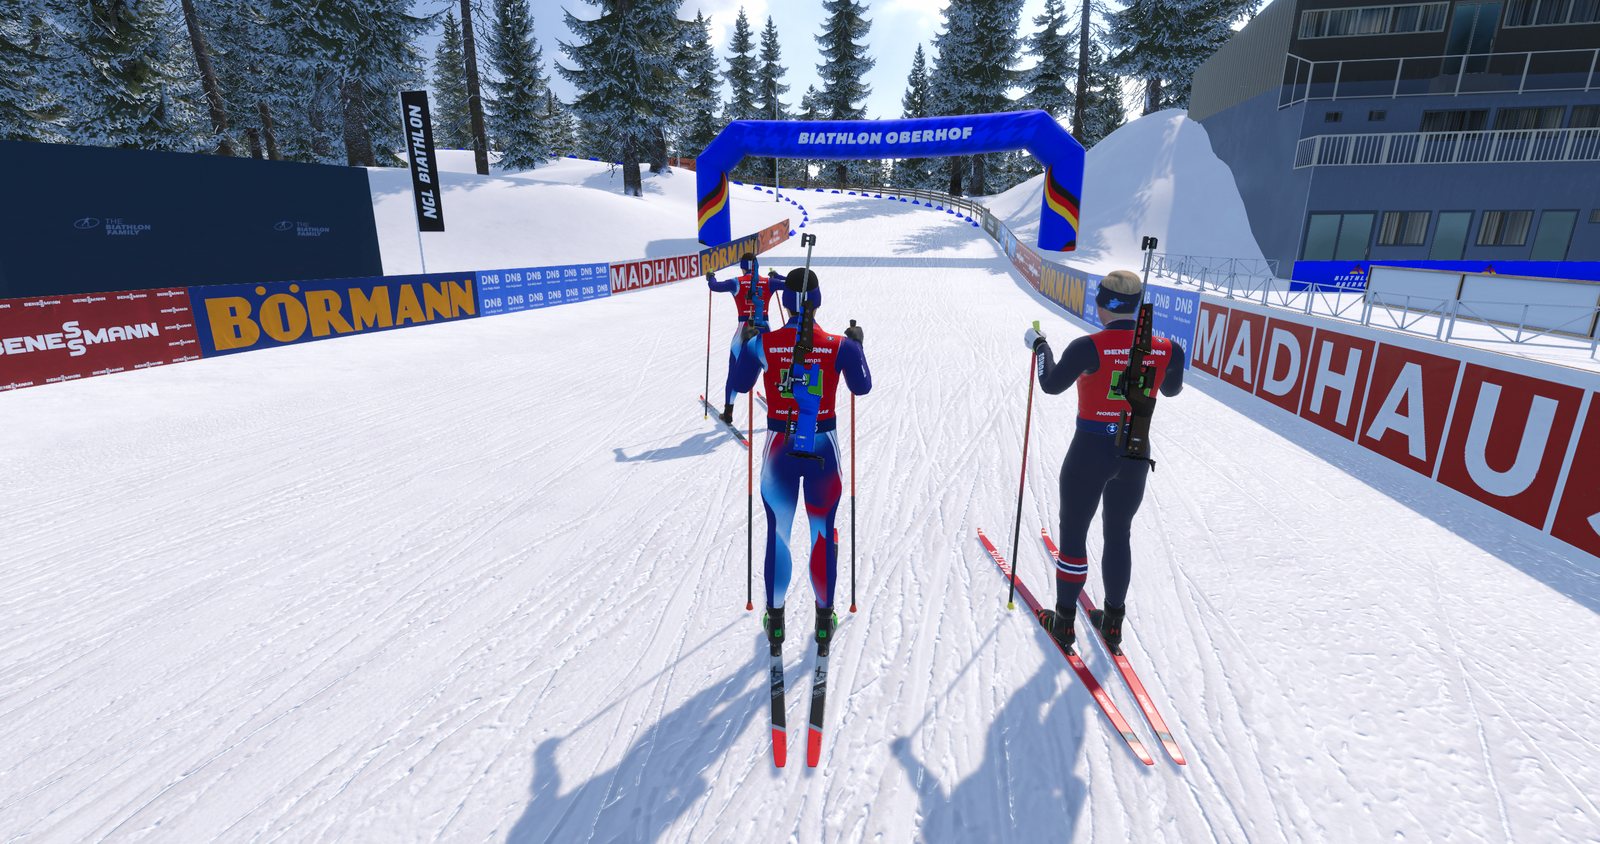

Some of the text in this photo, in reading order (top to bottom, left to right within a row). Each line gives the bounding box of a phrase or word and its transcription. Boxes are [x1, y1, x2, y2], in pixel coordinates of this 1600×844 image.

[798, 127, 973, 145] BIATHLON OBERHOF
[408, 104, 438, 219] NGL BIATHLON
[546, 270, 560, 279] DNB
[564, 269, 578, 278] DNB
[580, 267, 593, 276] DNB
[595, 266, 607, 275] DNB
[610, 254, 698, 291] MADHAUS
[481, 274, 500, 285] DNB
[505, 273, 522, 283] DNB
[526, 271, 542, 281] DNB
[566, 288, 579, 297] DNB
[582, 286, 594, 295] DNB
[597, 284, 609, 293] DNB
[529, 293, 544, 303] DNB
[548, 290, 562, 300] DNB
[484, 298, 503, 309] DNB
[507, 295, 524, 306] DNB
[1155, 293, 1170, 310] DNB
[1174, 297, 1193, 315] DNB
[204, 280, 477, 351] BÖRMANN
[0, 320, 160, 358] ENESSMANN
[1194, 308, 1600, 538] MADHAU
